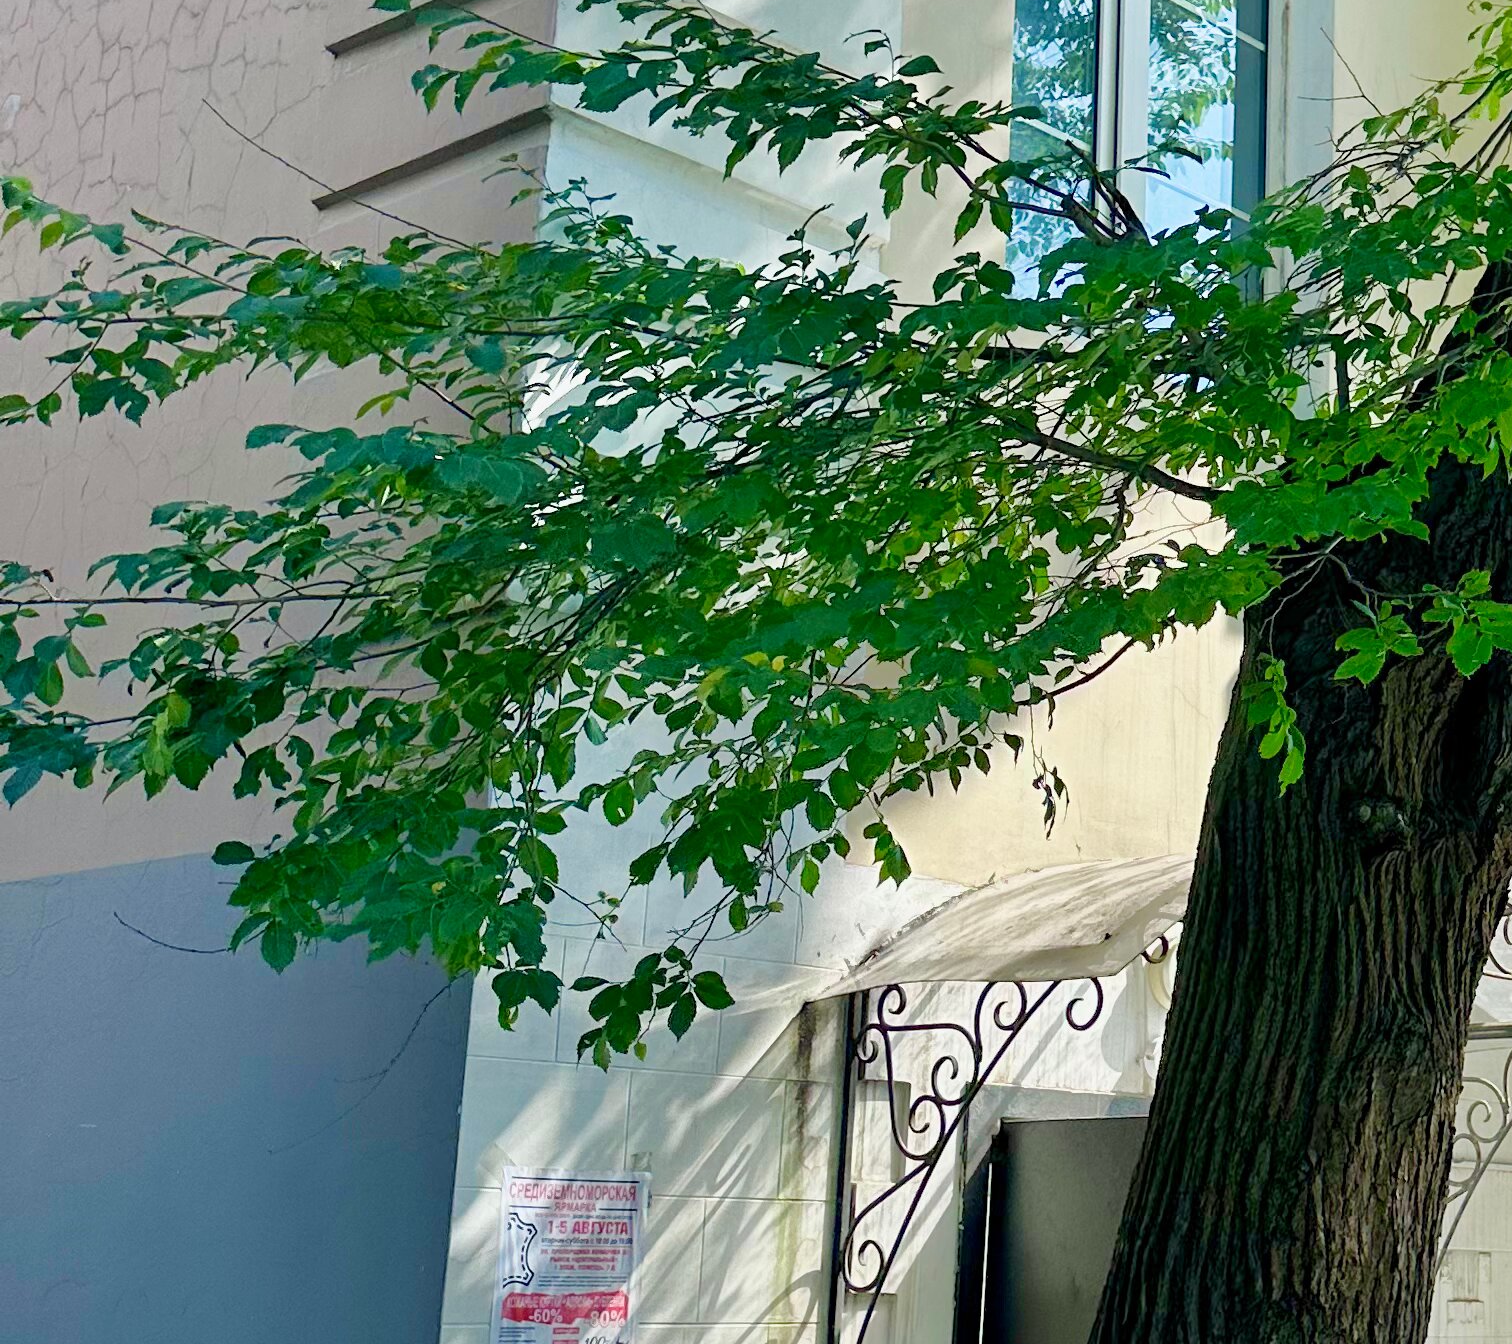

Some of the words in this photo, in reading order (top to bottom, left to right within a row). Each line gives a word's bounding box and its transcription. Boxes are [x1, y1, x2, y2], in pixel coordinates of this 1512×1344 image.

[509, 1183, 637, 1202] СРЕДИЗЕМНОМОРСКАЯ
[554, 1201, 597, 1213] ЯРМАРКА
[547, 1220, 567, 1234] 1-5
[572, 1221, 629, 1234] АВГУСТА
[528, 1308, 562, 1324] -60%
